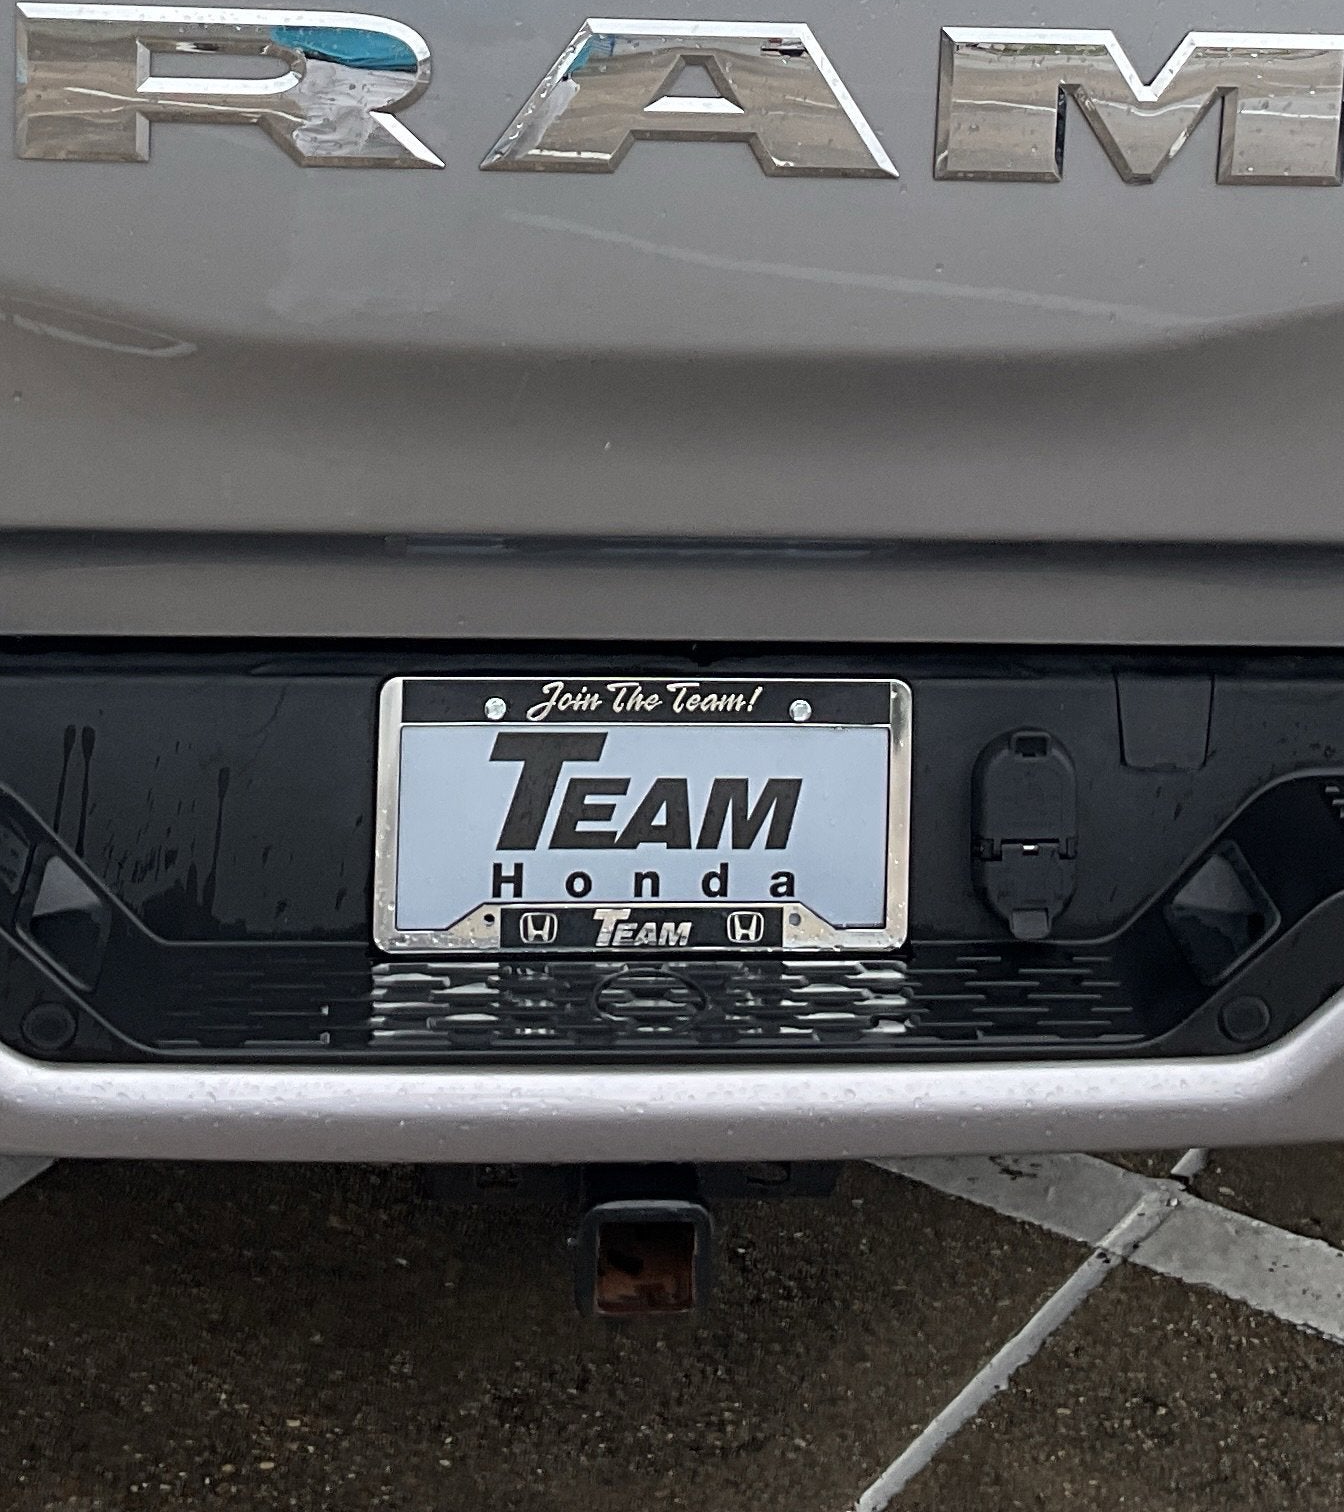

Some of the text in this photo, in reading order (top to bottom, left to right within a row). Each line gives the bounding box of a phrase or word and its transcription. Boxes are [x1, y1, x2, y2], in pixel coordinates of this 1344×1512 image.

[526, 681, 763, 722] Join The Team!
[489, 731, 803, 851] TEAM
[492, 862, 796, 899] Honda
[592, 908, 692, 948] TEAM
